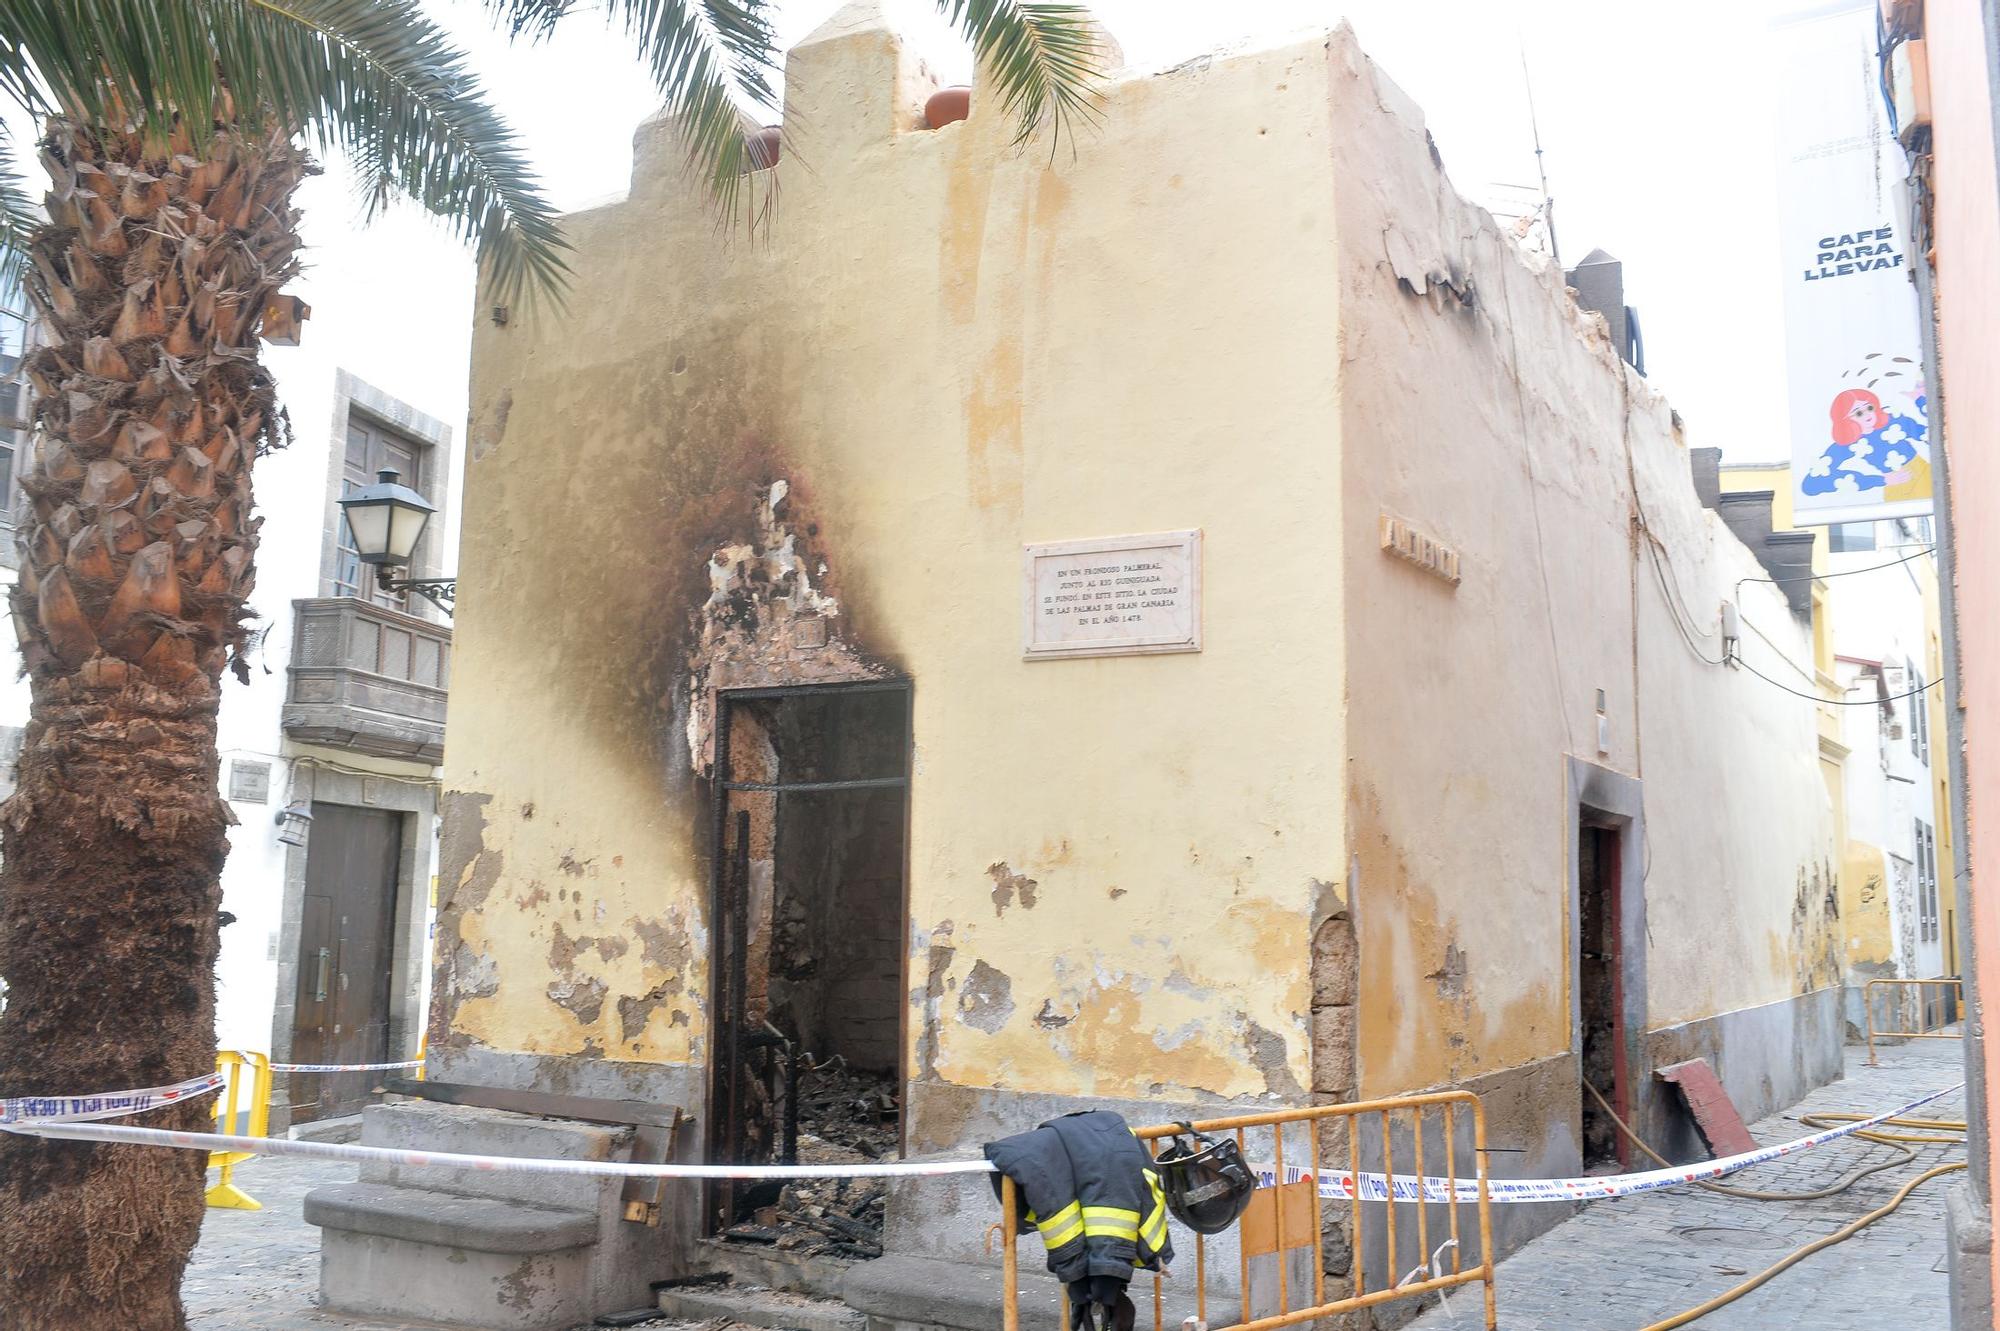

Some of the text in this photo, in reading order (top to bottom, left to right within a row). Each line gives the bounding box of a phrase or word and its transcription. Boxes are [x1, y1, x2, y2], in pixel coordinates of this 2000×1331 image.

[1818, 222, 1893, 249] CAFÉ
[1817, 242, 1894, 265] PARA
[1060, 582, 1083, 590] JUNTO
[1044, 596, 1053, 604] SE
[1082, 593, 1092, 601] EN
[1095, 591, 1111, 600] ESTE
[1137, 589, 1147, 597] LA
[1151, 587, 1178, 596] CIUDAD
[1057, 606, 1070, 615] LAS
[1073, 605, 1101, 614] PALMAS
[1104, 603, 1113, 611] DE
[1116, 601, 1138, 611] GRAN
[1141, 599, 1175, 609] CANARIA
[1079, 618, 1089, 626] EN
[1091, 617, 1100, 625] EL
[1103, 615, 1119, 625] AÑO
